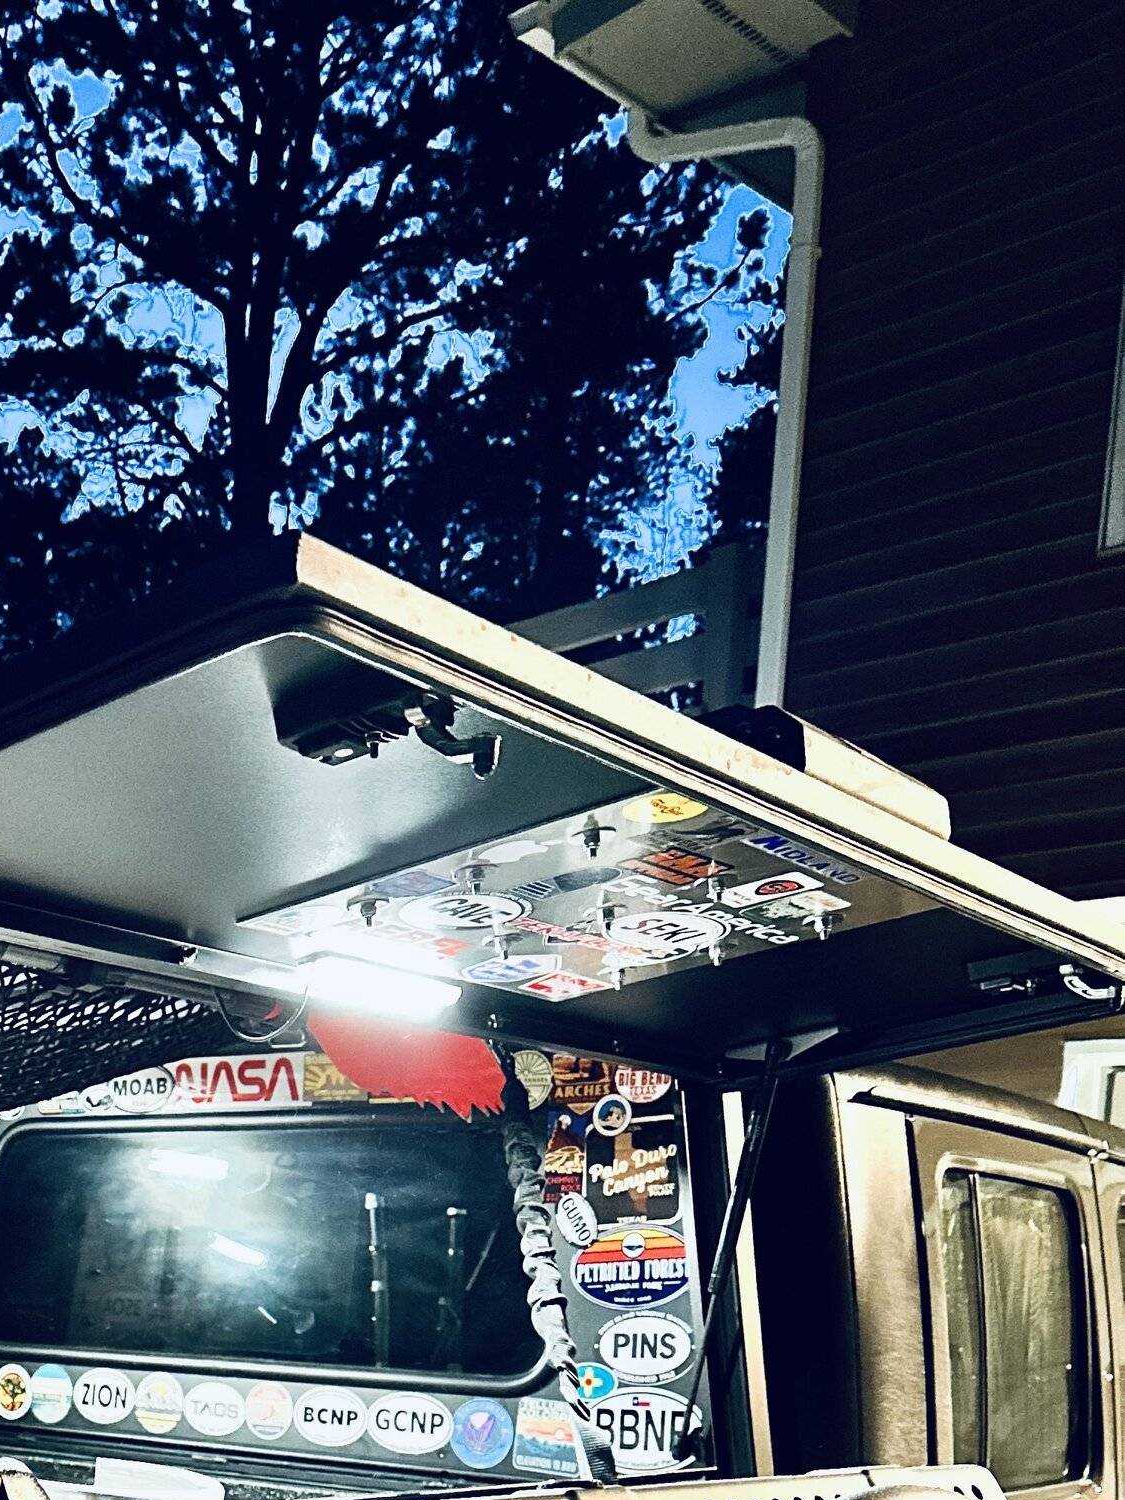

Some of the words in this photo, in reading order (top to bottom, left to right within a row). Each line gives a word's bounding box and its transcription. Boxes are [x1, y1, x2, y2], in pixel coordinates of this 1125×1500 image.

[750, 834, 861, 885] MIDLAND
[431, 898, 513, 925] CAVE
[601, 874, 800, 945] GearAmerica
[621, 918, 706, 945] SEKI
[113, 1077, 167, 1098] MOAB
[176, 1056, 299, 1104] NASA
[554, 1084, 611, 1099] ARCHES
[618, 1072, 636, 1086] BIG
[631, 1143, 677, 1169] Duro
[602, 1166, 669, 1197] Canyon
[561, 1197, 591, 1242] GUMO
[576, 1260, 640, 1284] PETRIFIED
[644, 1257, 690, 1280] FOREST
[613, 1332, 676, 1359] PINS
[81, 1383, 127, 1409] ZION
[302, 1405, 359, 1427] BCNP
[374, 1407, 445, 1435] GCNP
